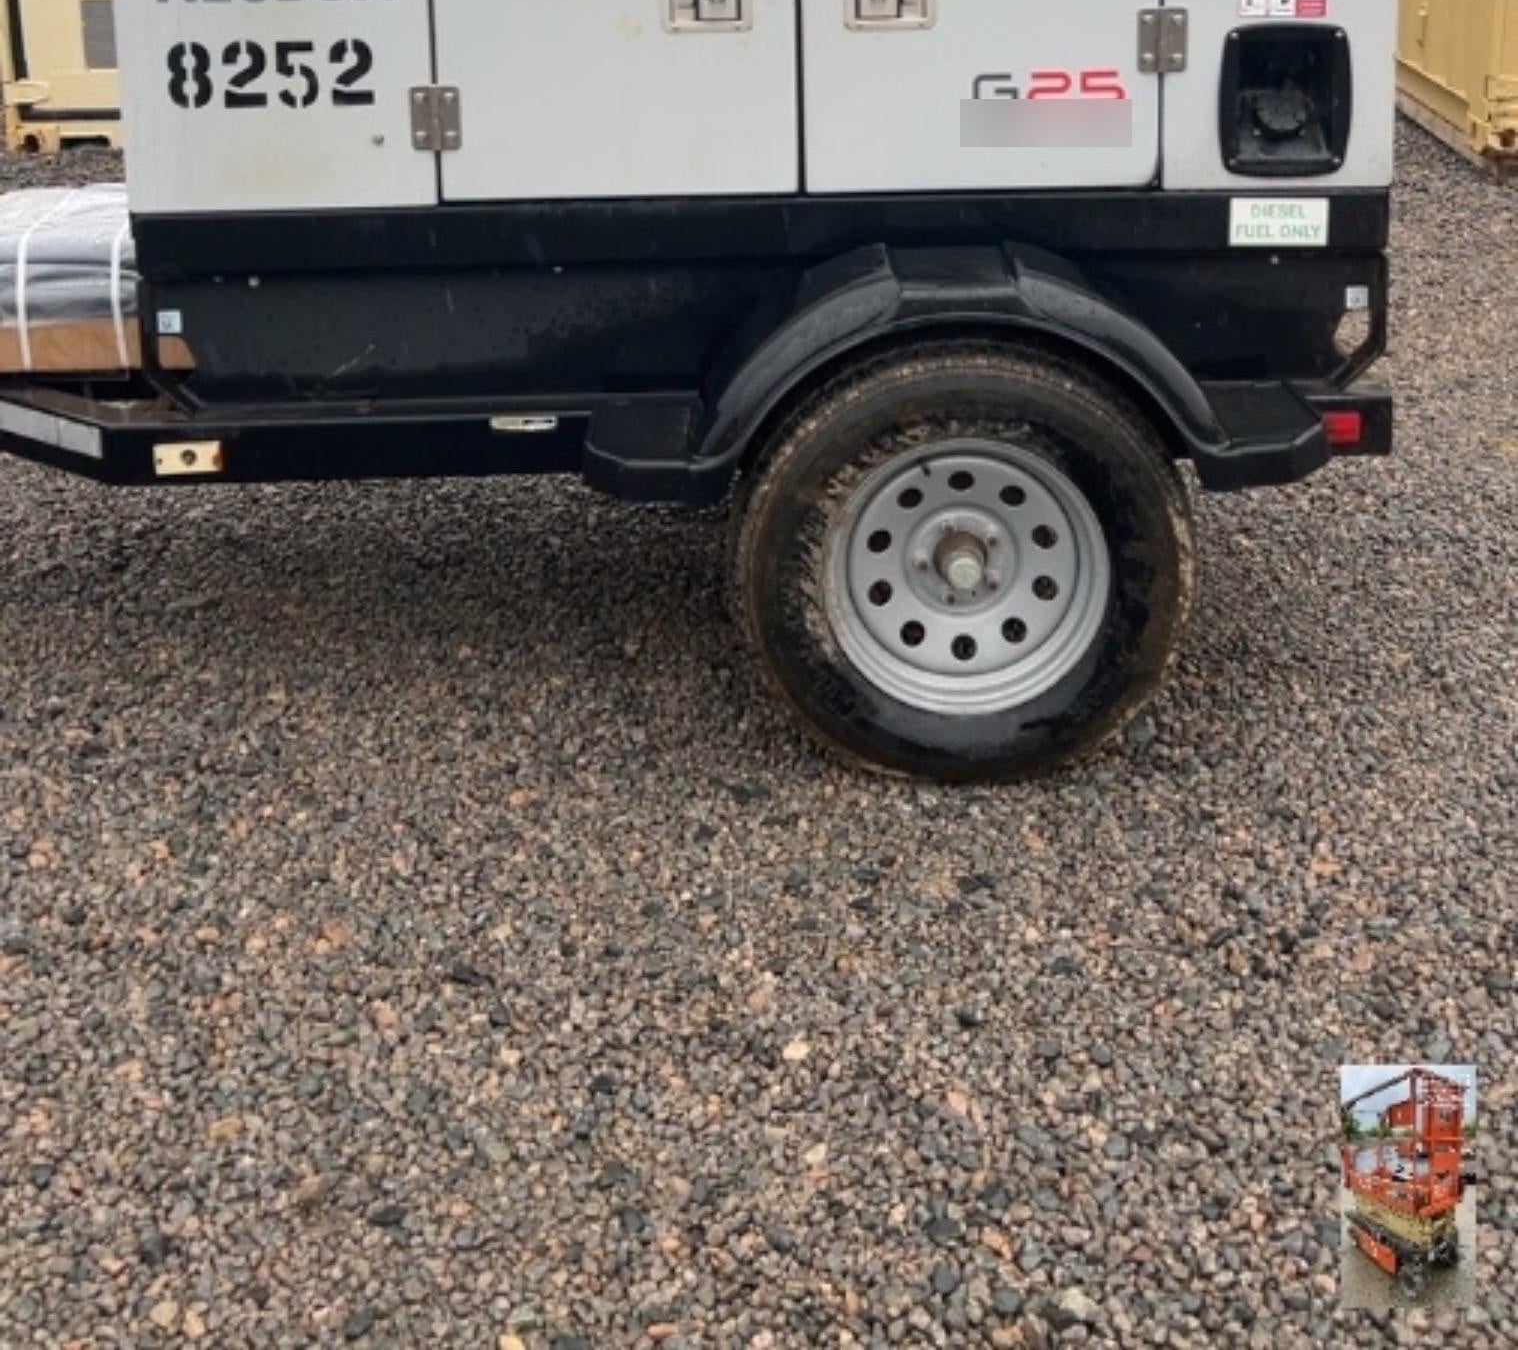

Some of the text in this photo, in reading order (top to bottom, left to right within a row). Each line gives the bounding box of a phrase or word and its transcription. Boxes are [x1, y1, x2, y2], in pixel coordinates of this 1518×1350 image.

[167, 38, 375, 109] 8252
[1250, 203, 1306, 220] DIESEL
[1235, 224, 1322, 238] FUEL ONLY
